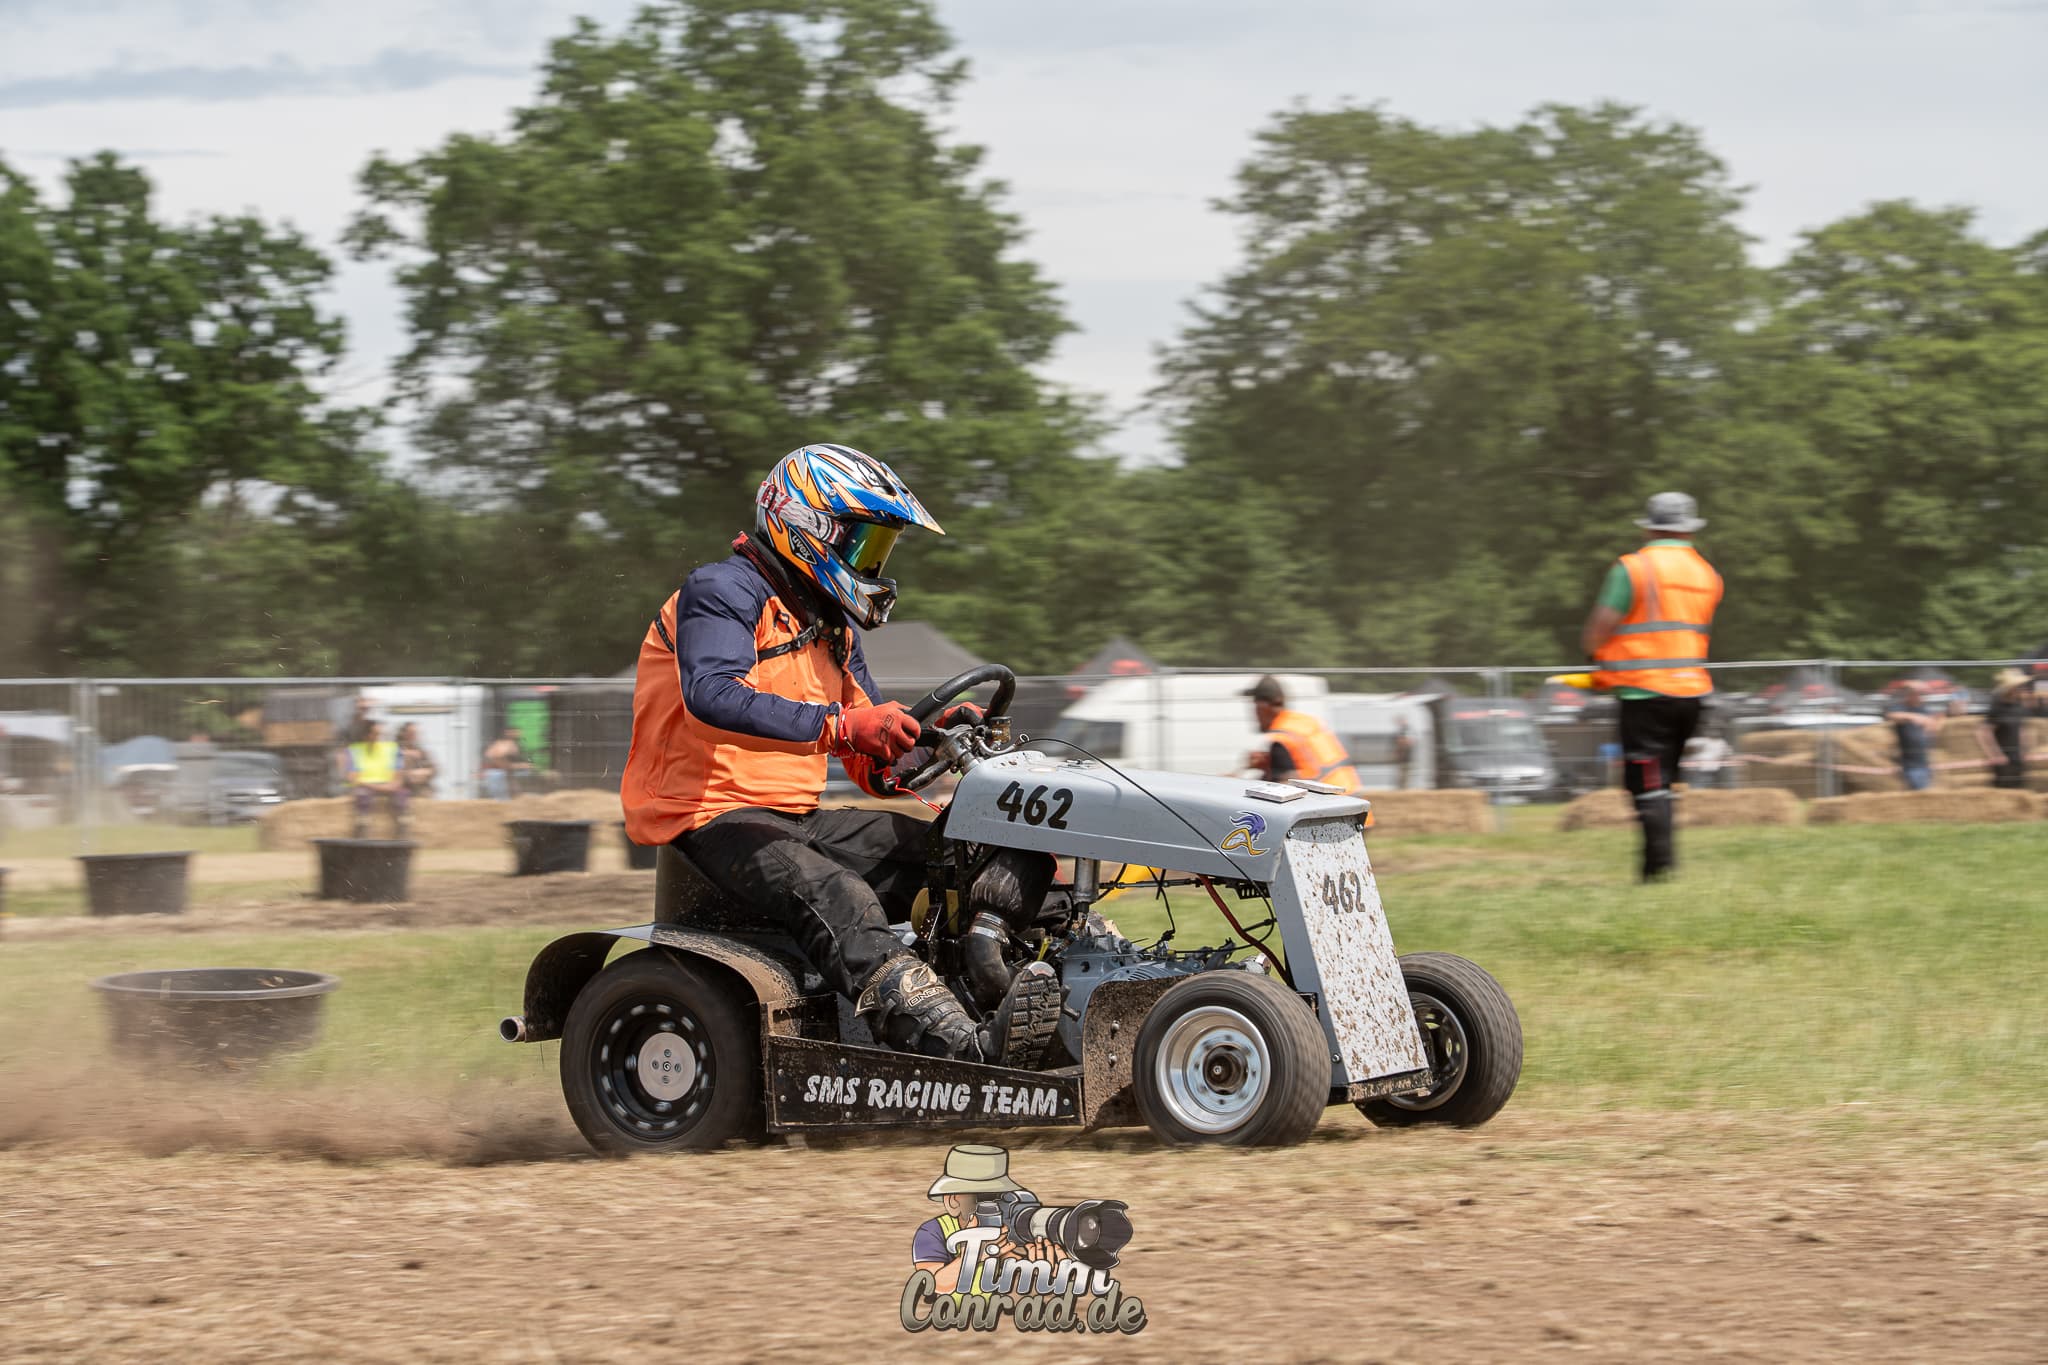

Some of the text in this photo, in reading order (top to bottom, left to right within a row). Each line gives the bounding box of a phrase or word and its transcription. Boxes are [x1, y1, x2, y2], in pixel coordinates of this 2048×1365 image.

[791, 534, 811, 559] uvex
[996, 780, 1074, 831] 462
[1322, 871, 1366, 915] 462
[803, 1074, 1059, 1117] SMS RACING TEAM
